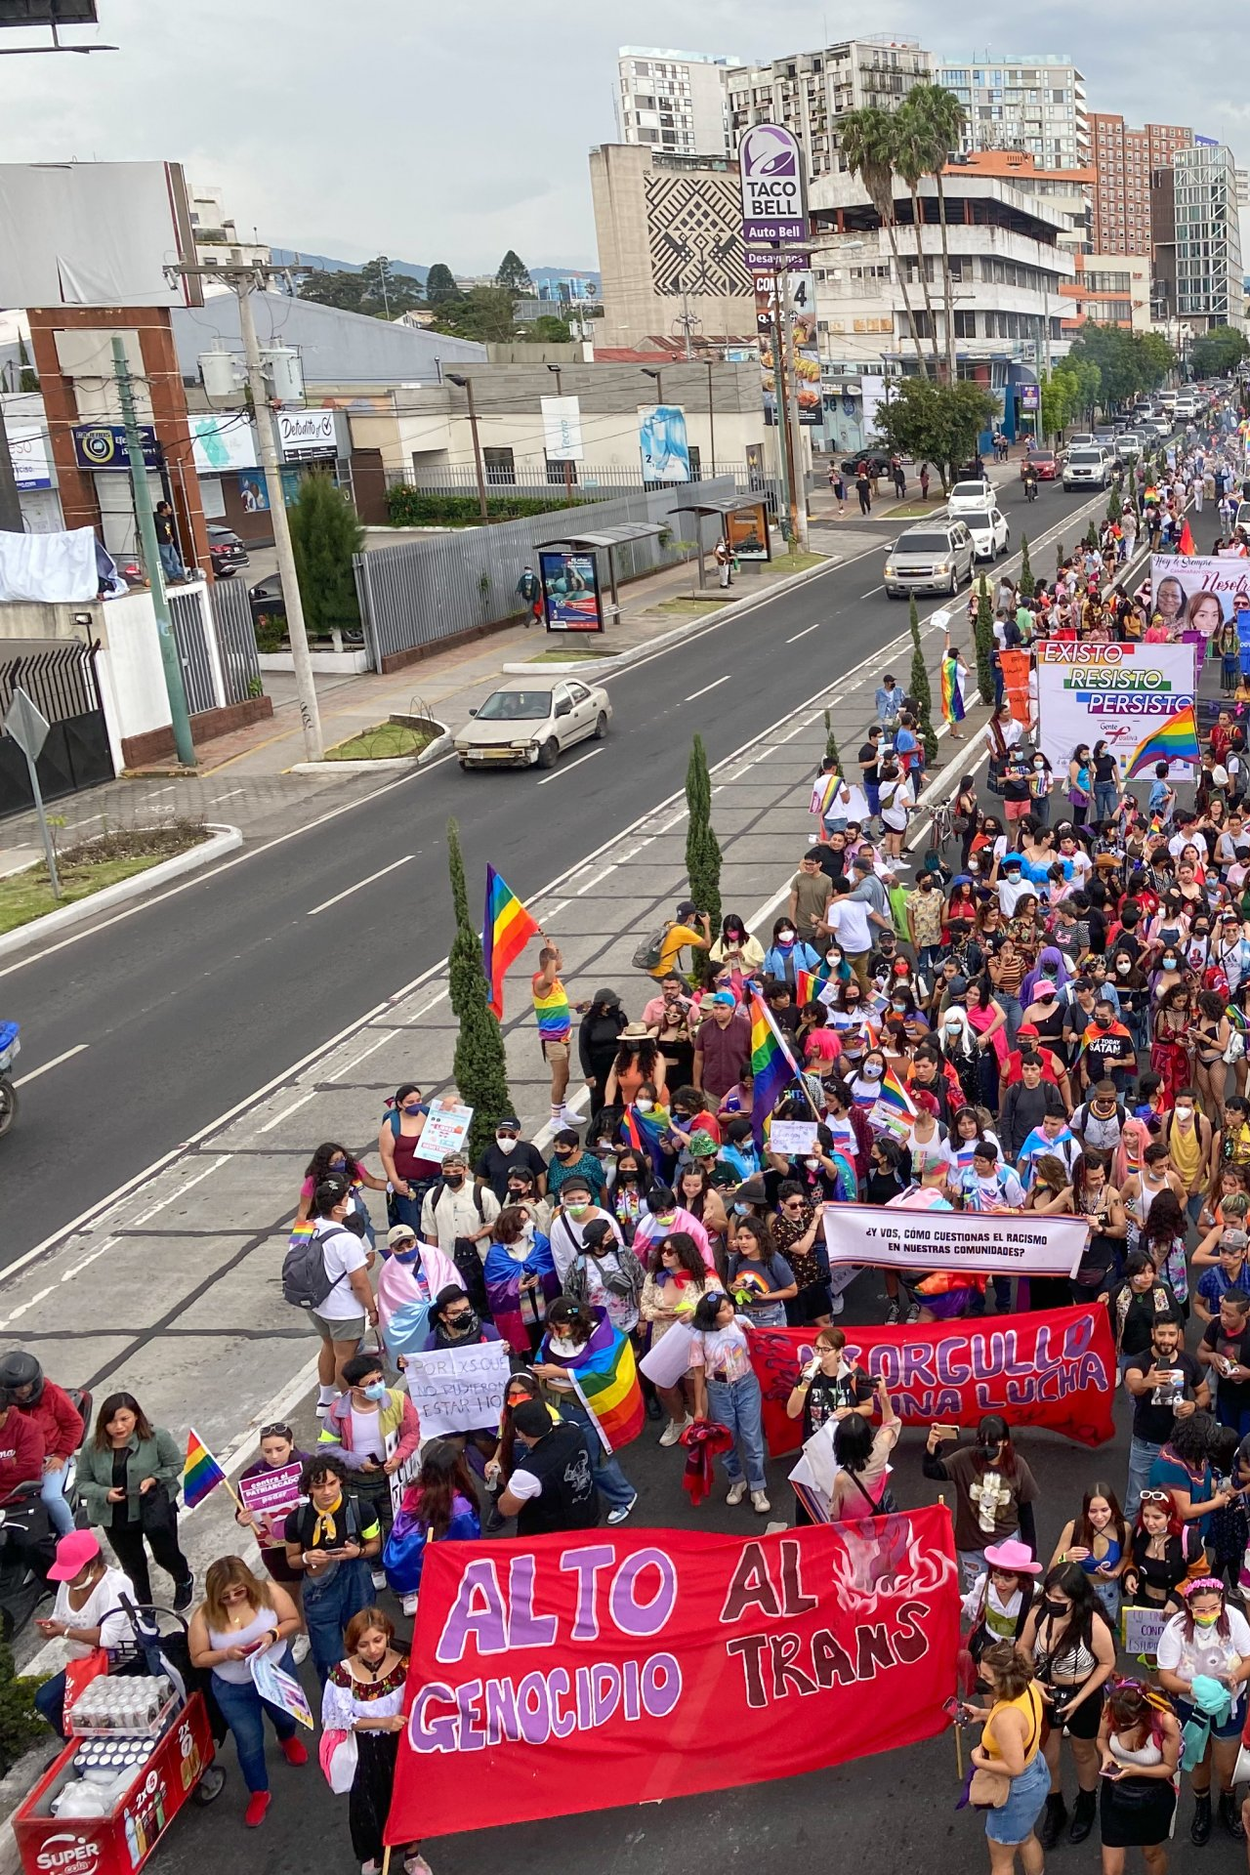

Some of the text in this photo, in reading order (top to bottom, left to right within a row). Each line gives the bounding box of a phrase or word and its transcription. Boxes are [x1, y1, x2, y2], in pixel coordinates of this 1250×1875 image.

[747, 181, 796, 197] TACO
[752, 200, 797, 215] BELL
[749, 226, 800, 238] Auto Bell
[281, 418, 315, 438] Detodito
[1044, 643, 1123, 664] EXISTO
[1070, 668, 1163, 689] RESISTO
[1088, 694, 1194, 714] PERSISTO
[1100, 722, 1118, 730] Gente
[1090, 1043, 1120, 1054] SATAN
[880, 1228, 901, 1240] VOS,
[934, 1231, 990, 1243] CUESTIONAS
[993, 1232, 1004, 1243] EL
[1006, 1233, 1047, 1246] RACISMO
[888, 1242, 1025, 1258] EN NUESTRAS COMUNIDADES?
[867, 1314, 1095, 1390] ORGULLO
[412, 1360, 447, 1376] POR
[480, 1356, 508, 1371] QUE
[976, 1351, 1109, 1409] LUCHA
[417, 1385, 437, 1397] NO
[422, 1394, 502, 1417] ESTAR HO
[246, 1476, 300, 1497] PATRIARCADO
[250, 1475, 279, 1490] contra
[435, 1540, 818, 1663] ALTO AL
[407, 1600, 933, 1754] GENOCIDIO TRANS
[36, 1843, 99, 1869] SUPER
[64, 1860, 89, 1874] cola
